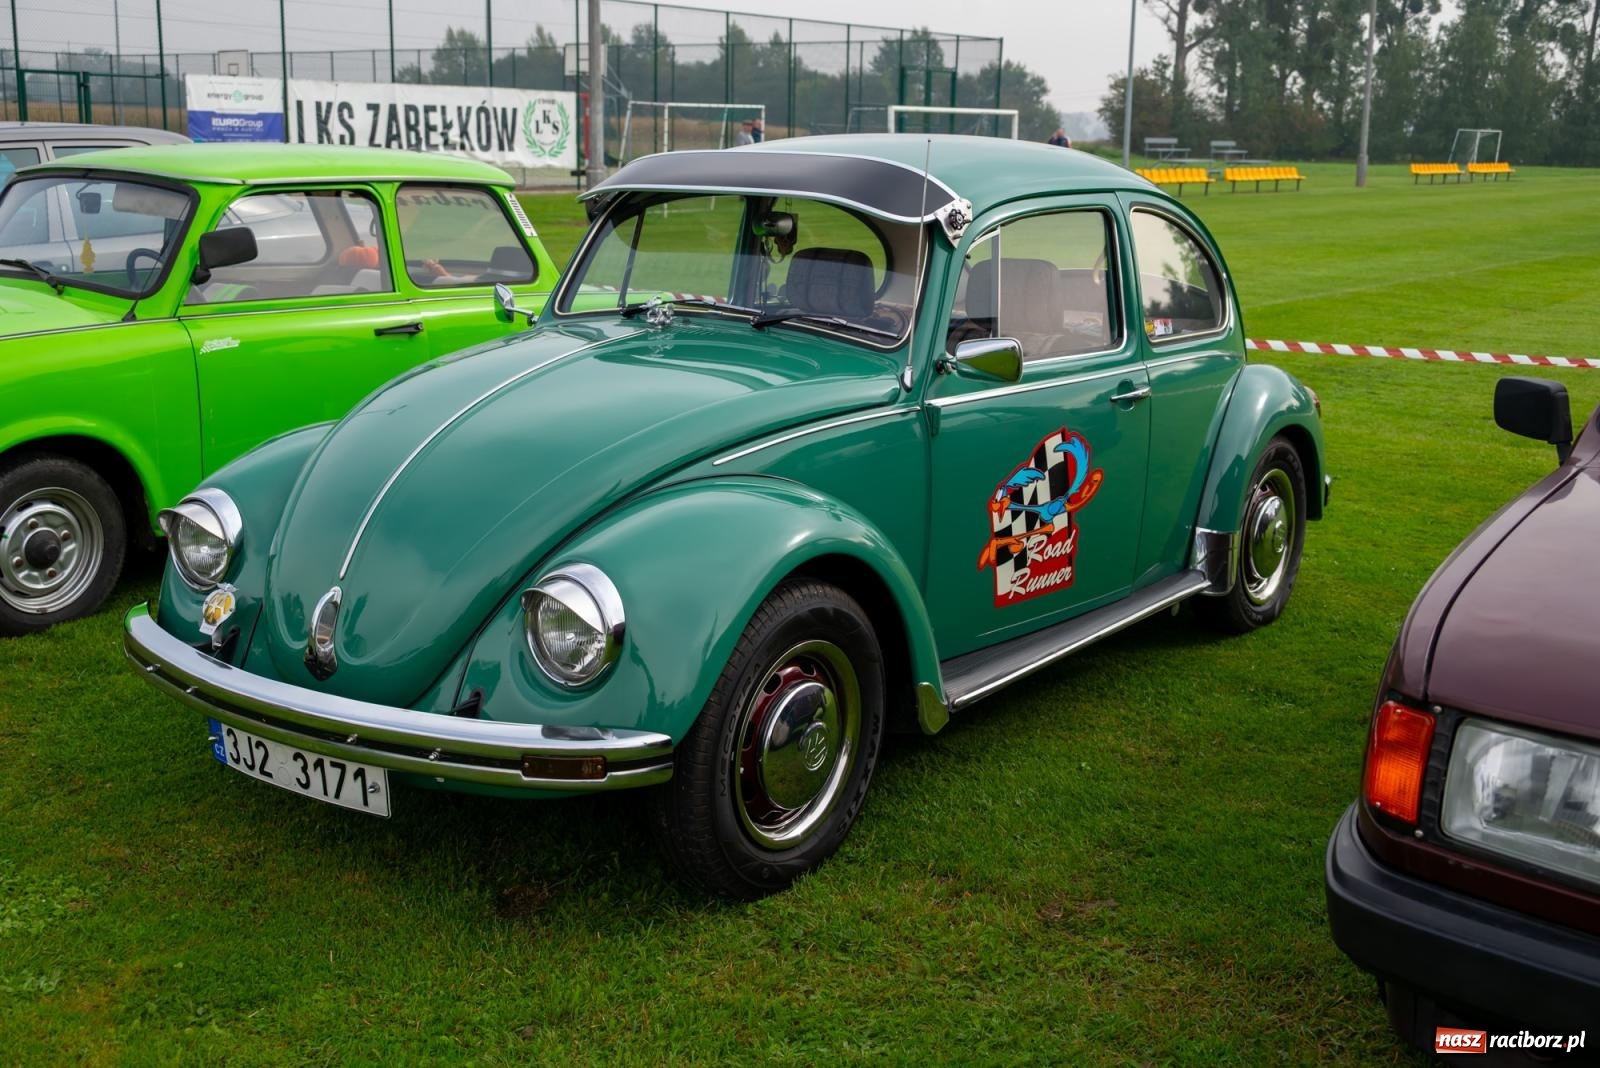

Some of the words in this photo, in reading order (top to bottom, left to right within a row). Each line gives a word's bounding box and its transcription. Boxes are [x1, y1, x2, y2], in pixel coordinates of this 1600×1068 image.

[366, 100, 517, 152] ZABEŁKÓW
[1026, 529, 1076, 566] Road
[1008, 566, 1072, 599] Runner
[215, 743, 225, 757] CZ
[227, 728, 273, 778] 3J2
[292, 752, 369, 807] 3171
